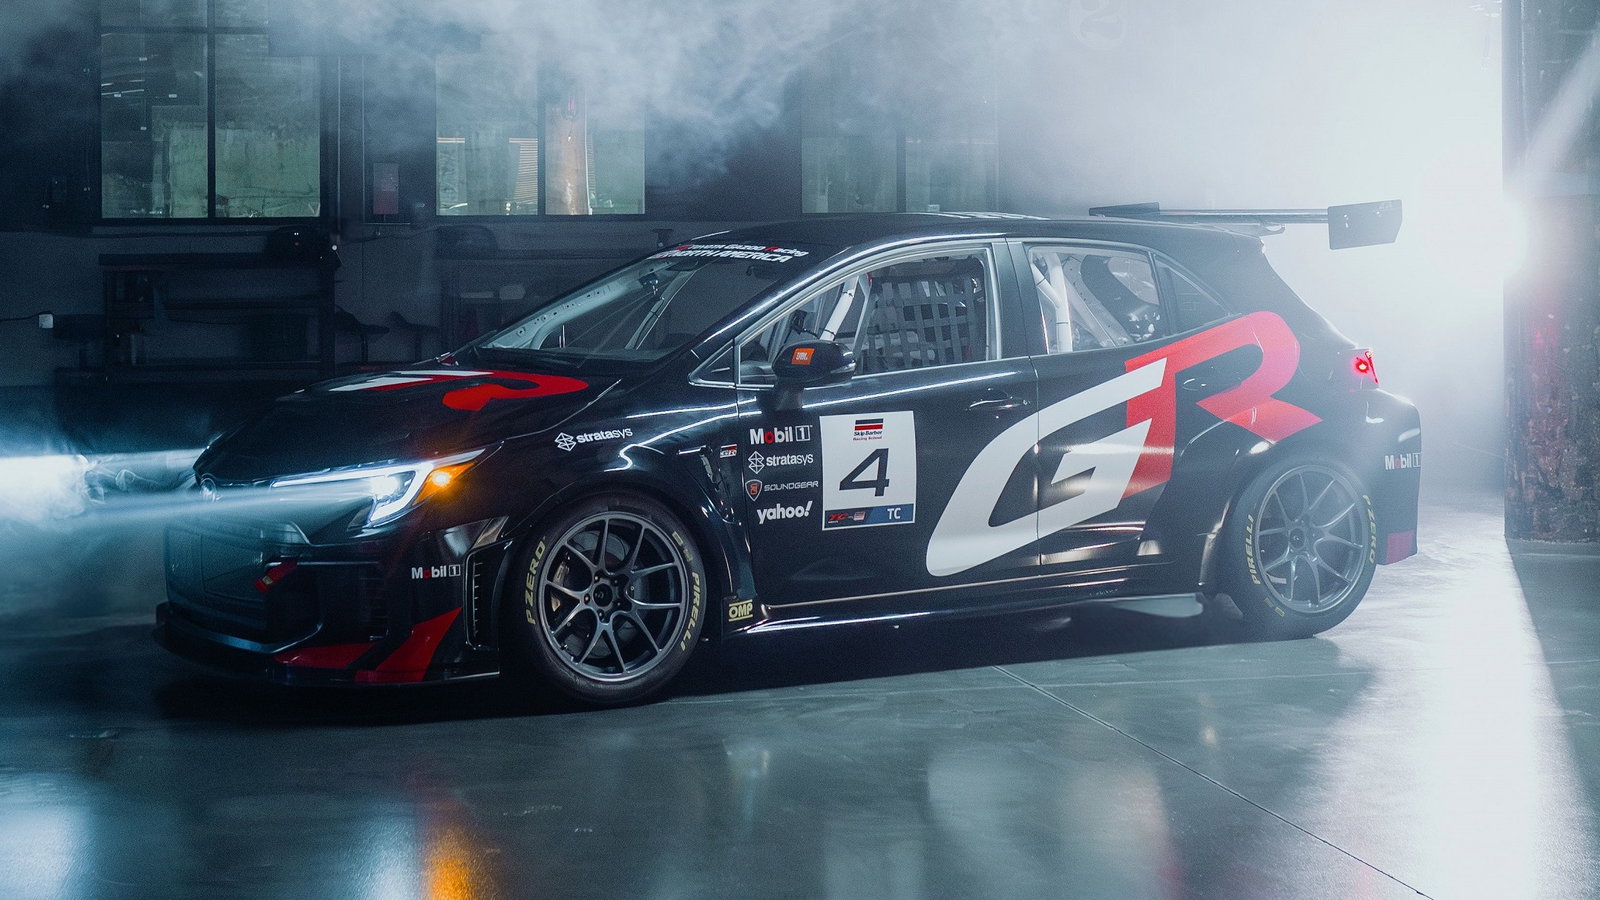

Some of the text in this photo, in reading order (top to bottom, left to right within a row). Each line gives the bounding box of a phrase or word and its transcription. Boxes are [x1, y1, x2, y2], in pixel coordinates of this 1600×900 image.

[718, 250, 793, 263] AMERICA
[576, 428, 633, 443] stratasys
[749, 426, 793, 445] Mobil
[926, 311, 1322, 577] GR
[766, 454, 814, 466] stratasys
[1384, 453, 1412, 470] Mobil
[839, 448, 890, 497] 4
[764, 481, 819, 492] SOUNDGEAR
[757, 500, 813, 525] yahoo!
[887, 508, 901, 520] TC
[1245, 514, 1261, 585] PIRELLI
[411, 565, 447, 580] Mobil
[524, 541, 546, 607] ZERO
[680, 571, 701, 651] PIRELLI
[729, 602, 753, 618] OMP
